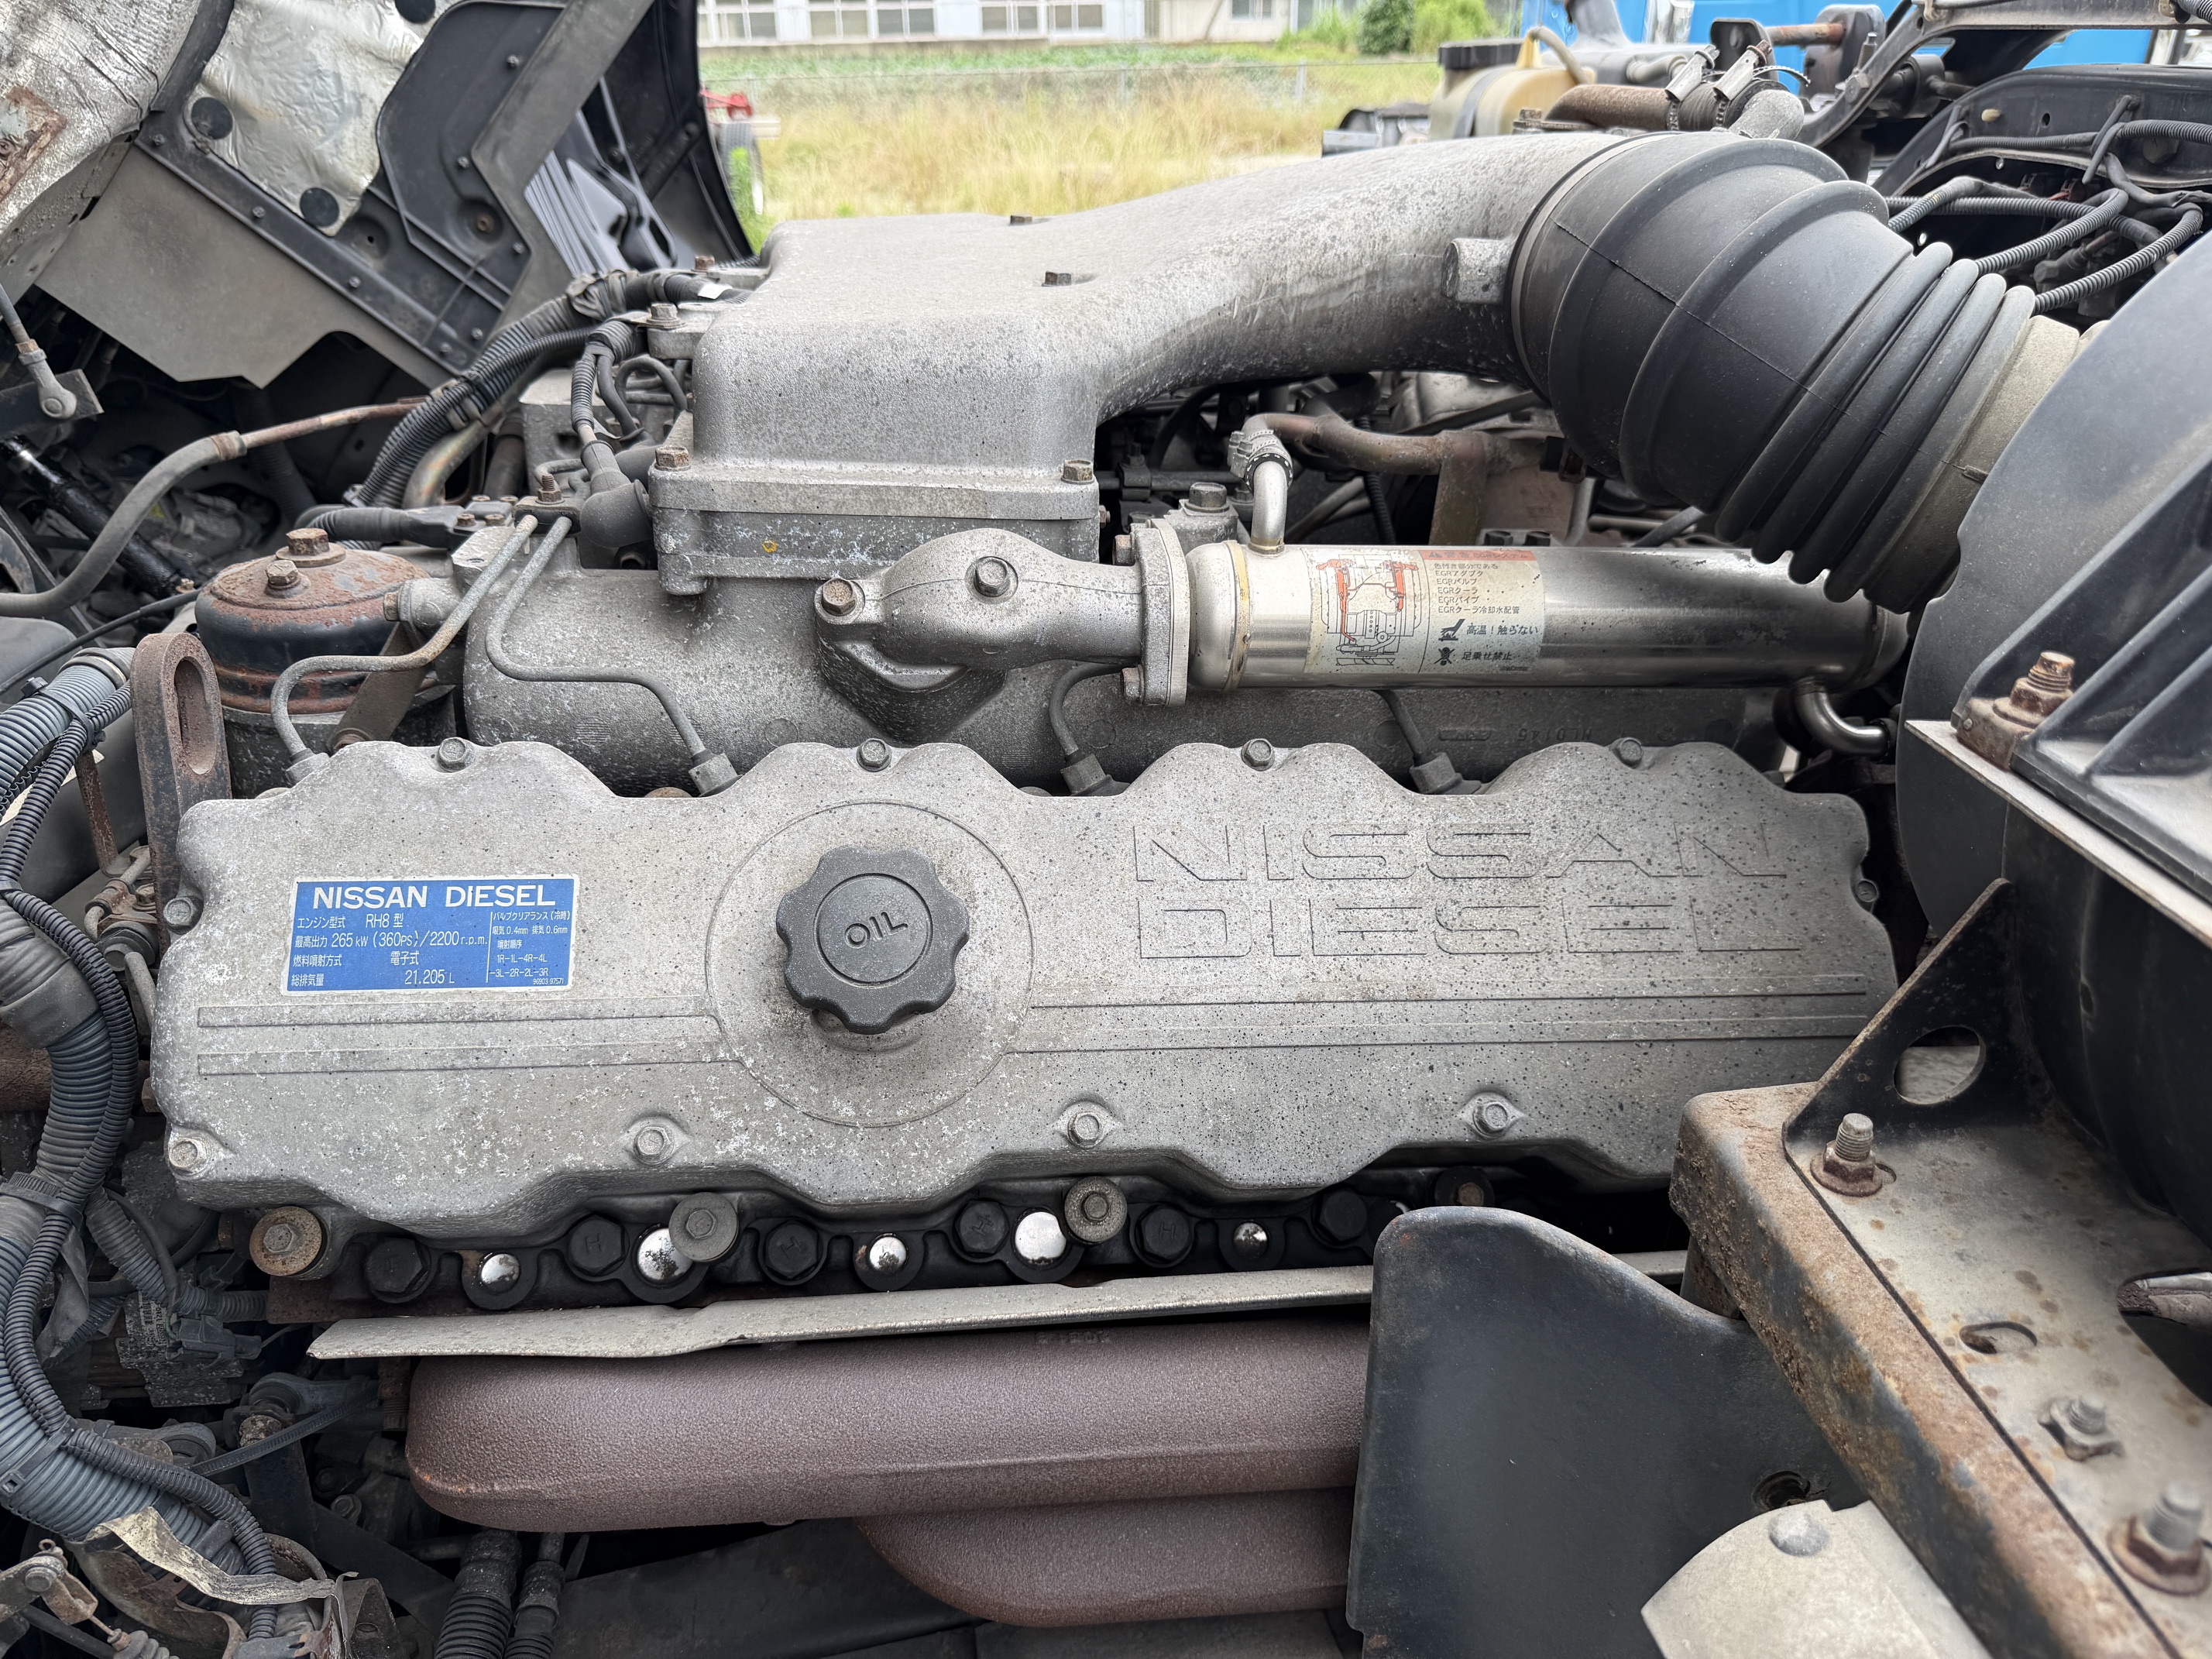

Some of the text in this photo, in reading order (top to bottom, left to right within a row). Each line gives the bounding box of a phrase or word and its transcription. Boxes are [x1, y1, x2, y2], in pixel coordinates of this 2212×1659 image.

[1462, 651, 1512, 661] 足乗せ禁止
[1134, 823, 1787, 881] NISSAN
[314, 884, 555, 908] NISSAN DIESEL
[297, 913, 404, 928] エンジン型式 RH8 型
[1138, 895, 1801, 959] DIESEL
[844, 912, 908, 949] OIL
[295, 936, 327, 947] 最高出力
[498, 939, 522, 949] 噴射順序
[293, 950, 419, 967] 燃料噴射方式 電子式
[291, 970, 455, 986] 総排気量 21.205 L
